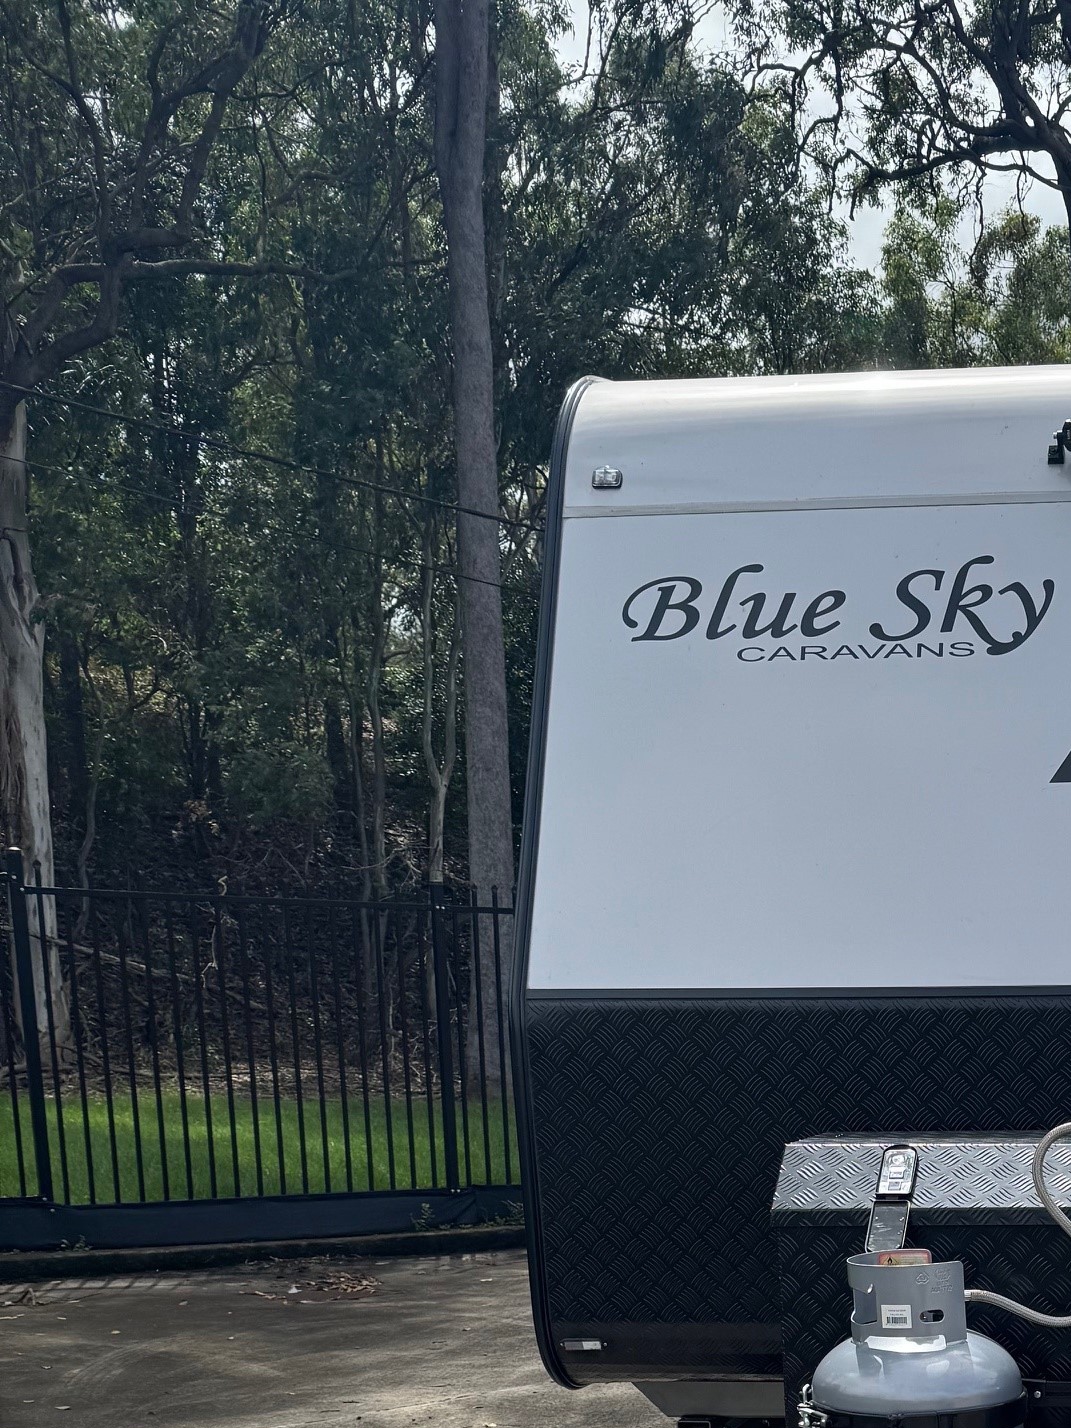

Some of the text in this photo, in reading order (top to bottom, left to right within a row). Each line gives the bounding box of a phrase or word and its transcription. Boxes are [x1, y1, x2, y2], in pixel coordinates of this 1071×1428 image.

[622, 555, 1055, 656] Blue Sky
[736, 641, 975, 663] CARAVANS
